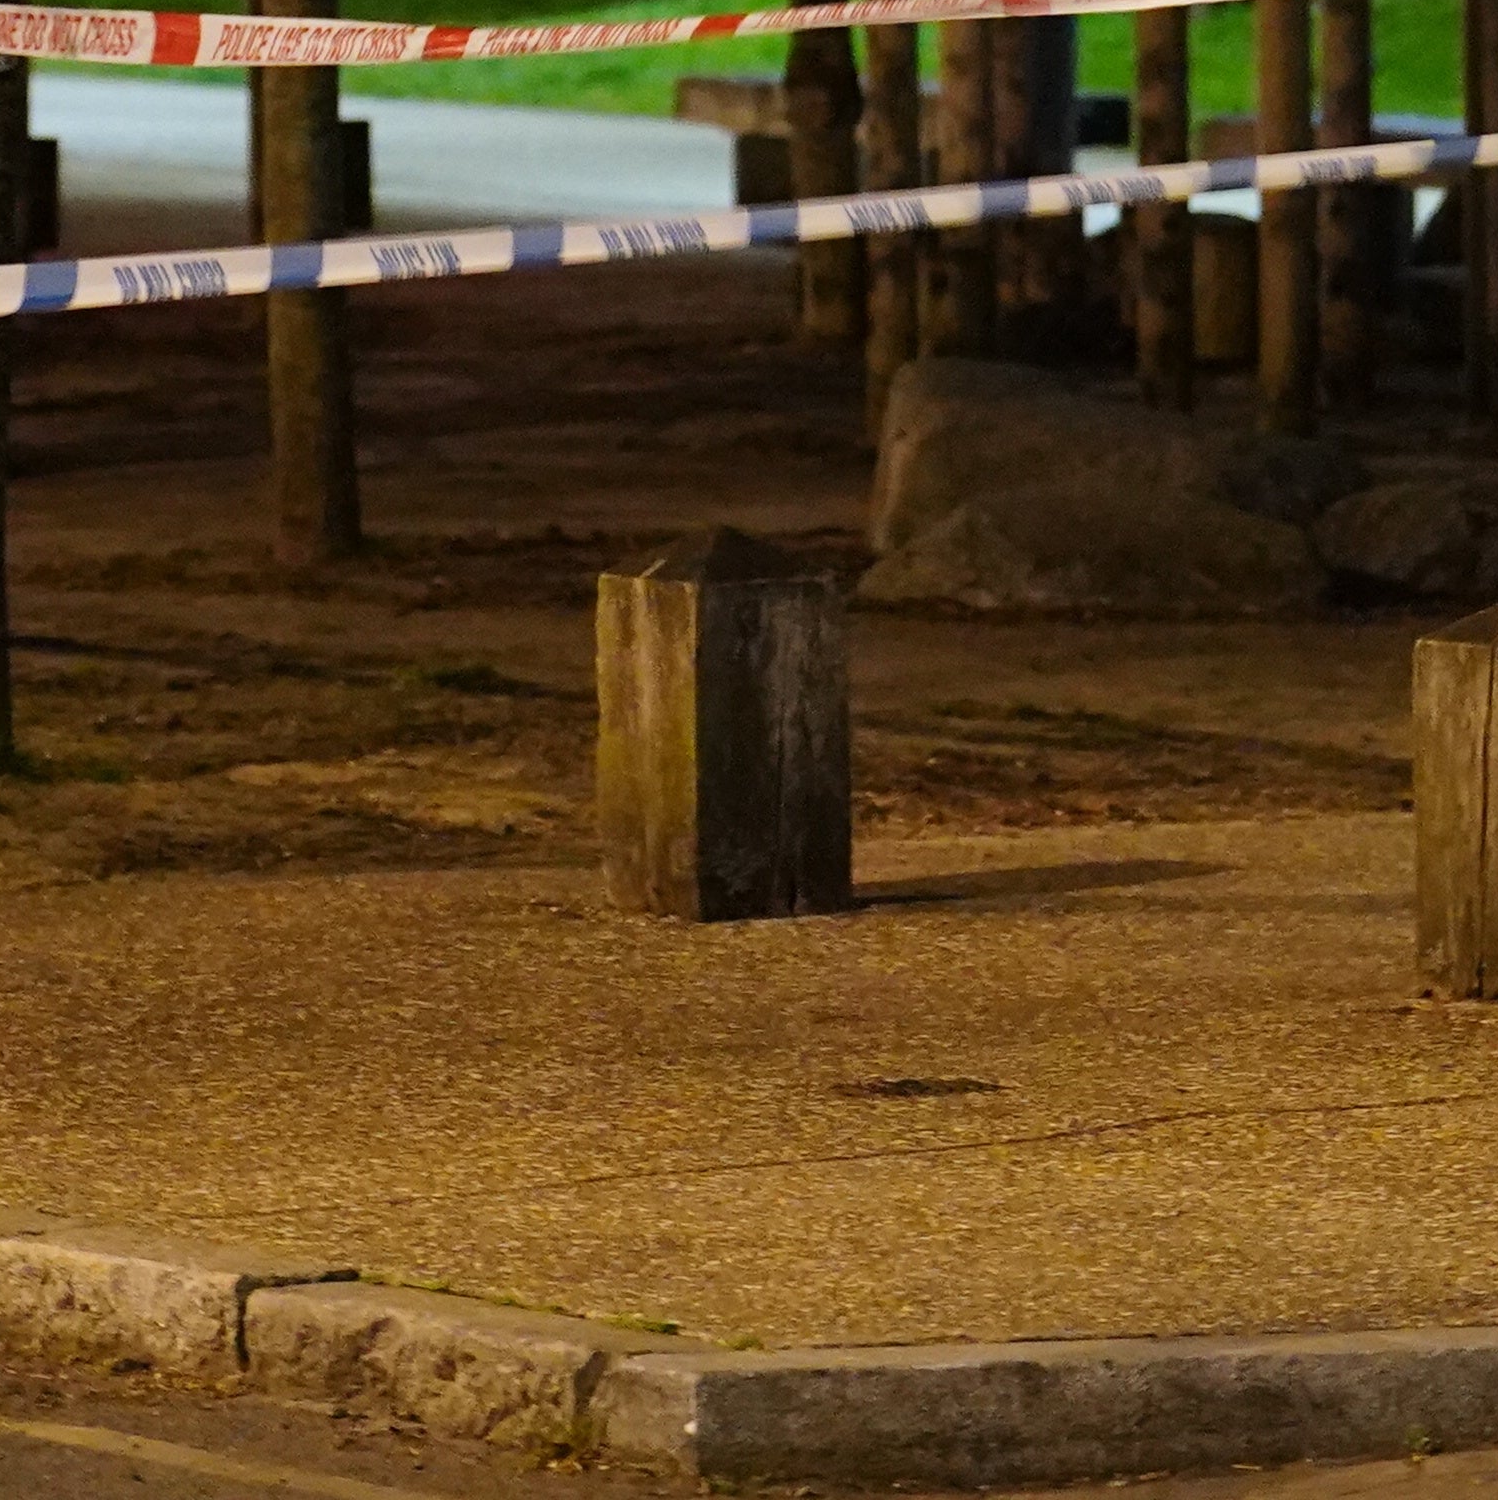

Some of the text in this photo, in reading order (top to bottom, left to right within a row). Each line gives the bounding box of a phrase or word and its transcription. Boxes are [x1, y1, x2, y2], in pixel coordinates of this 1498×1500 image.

[22, 12, 47, 50] DO
[83, 15, 137, 55] CROSS
[214, 22, 273, 60] POLICE
[304, 25, 331, 60] DO
[357, 24, 415, 59] CROSS
